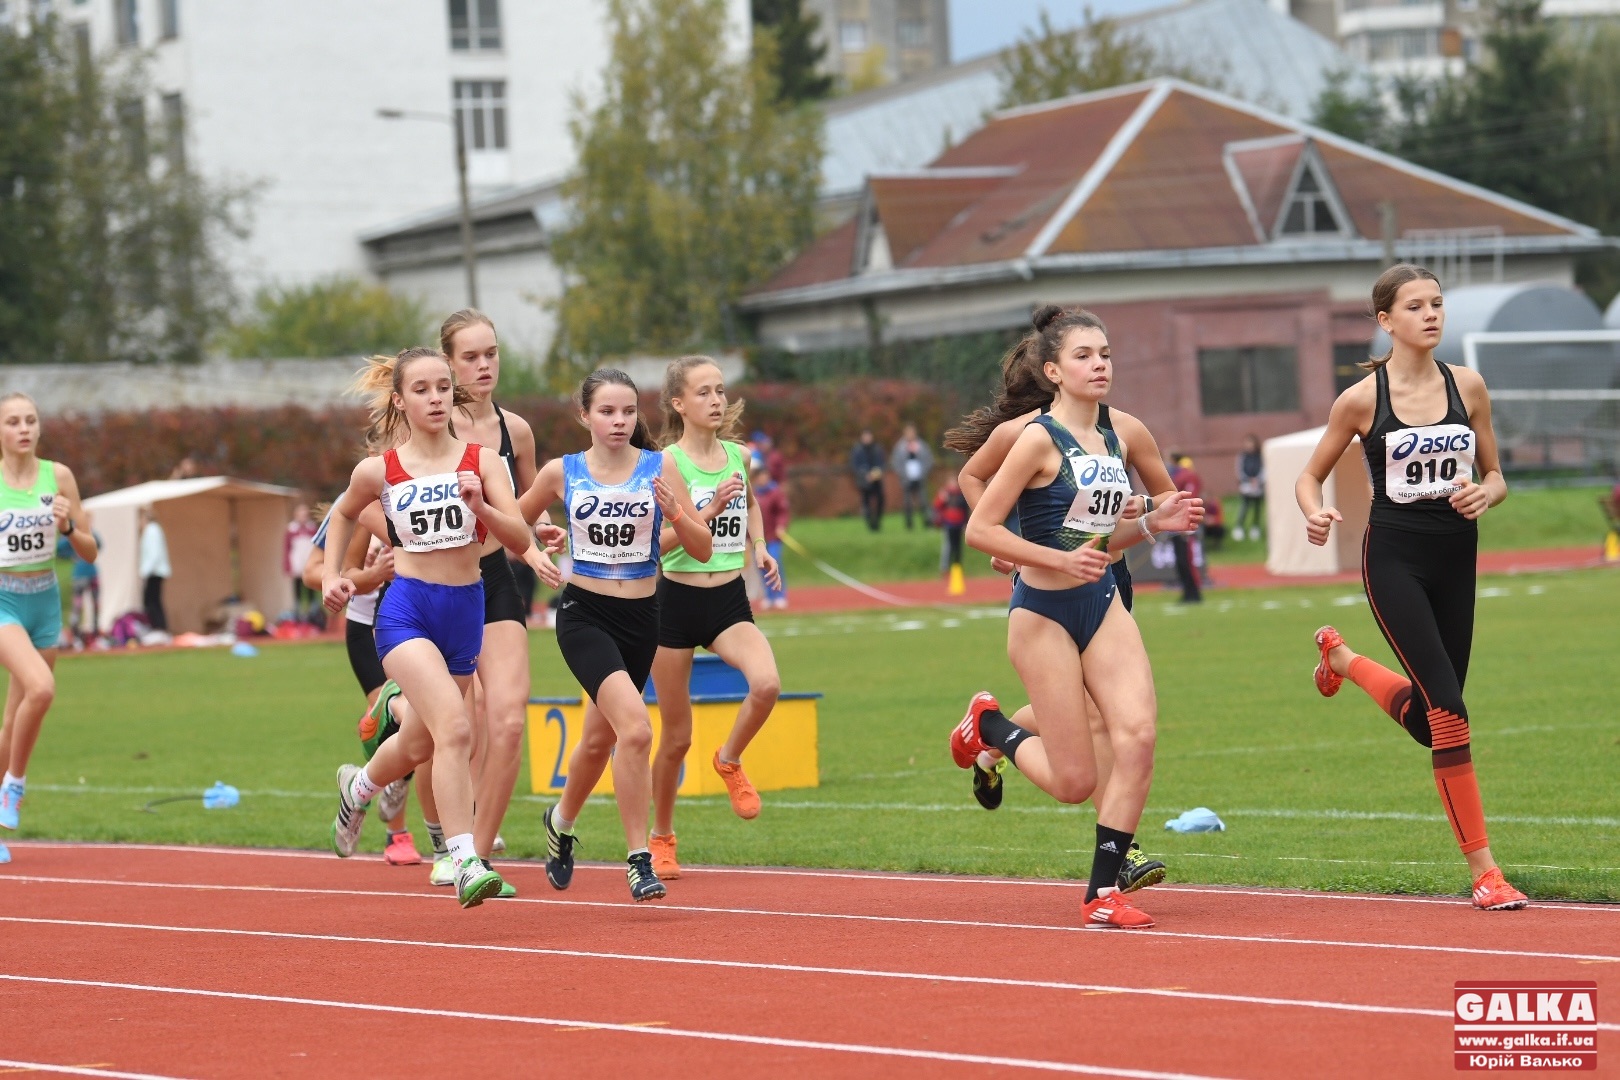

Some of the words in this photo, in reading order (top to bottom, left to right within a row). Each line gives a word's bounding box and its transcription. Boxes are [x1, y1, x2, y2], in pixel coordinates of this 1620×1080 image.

[1419, 433, 1470, 454] asics
[1100, 465, 1127, 484] asics
[1405, 458, 1457, 485] 910
[420, 483, 461, 503] asic
[1087, 489, 1123, 515] 318
[1398, 489, 1437, 499] Черкаська
[409, 504, 463, 535] 570
[598, 501, 649, 518] asics
[15, 513, 54, 528] asics
[708, 516, 741, 538] 956
[7, 532, 45, 552] 963
[587, 523, 636, 548] 689
[545, 708, 567, 788] 2
